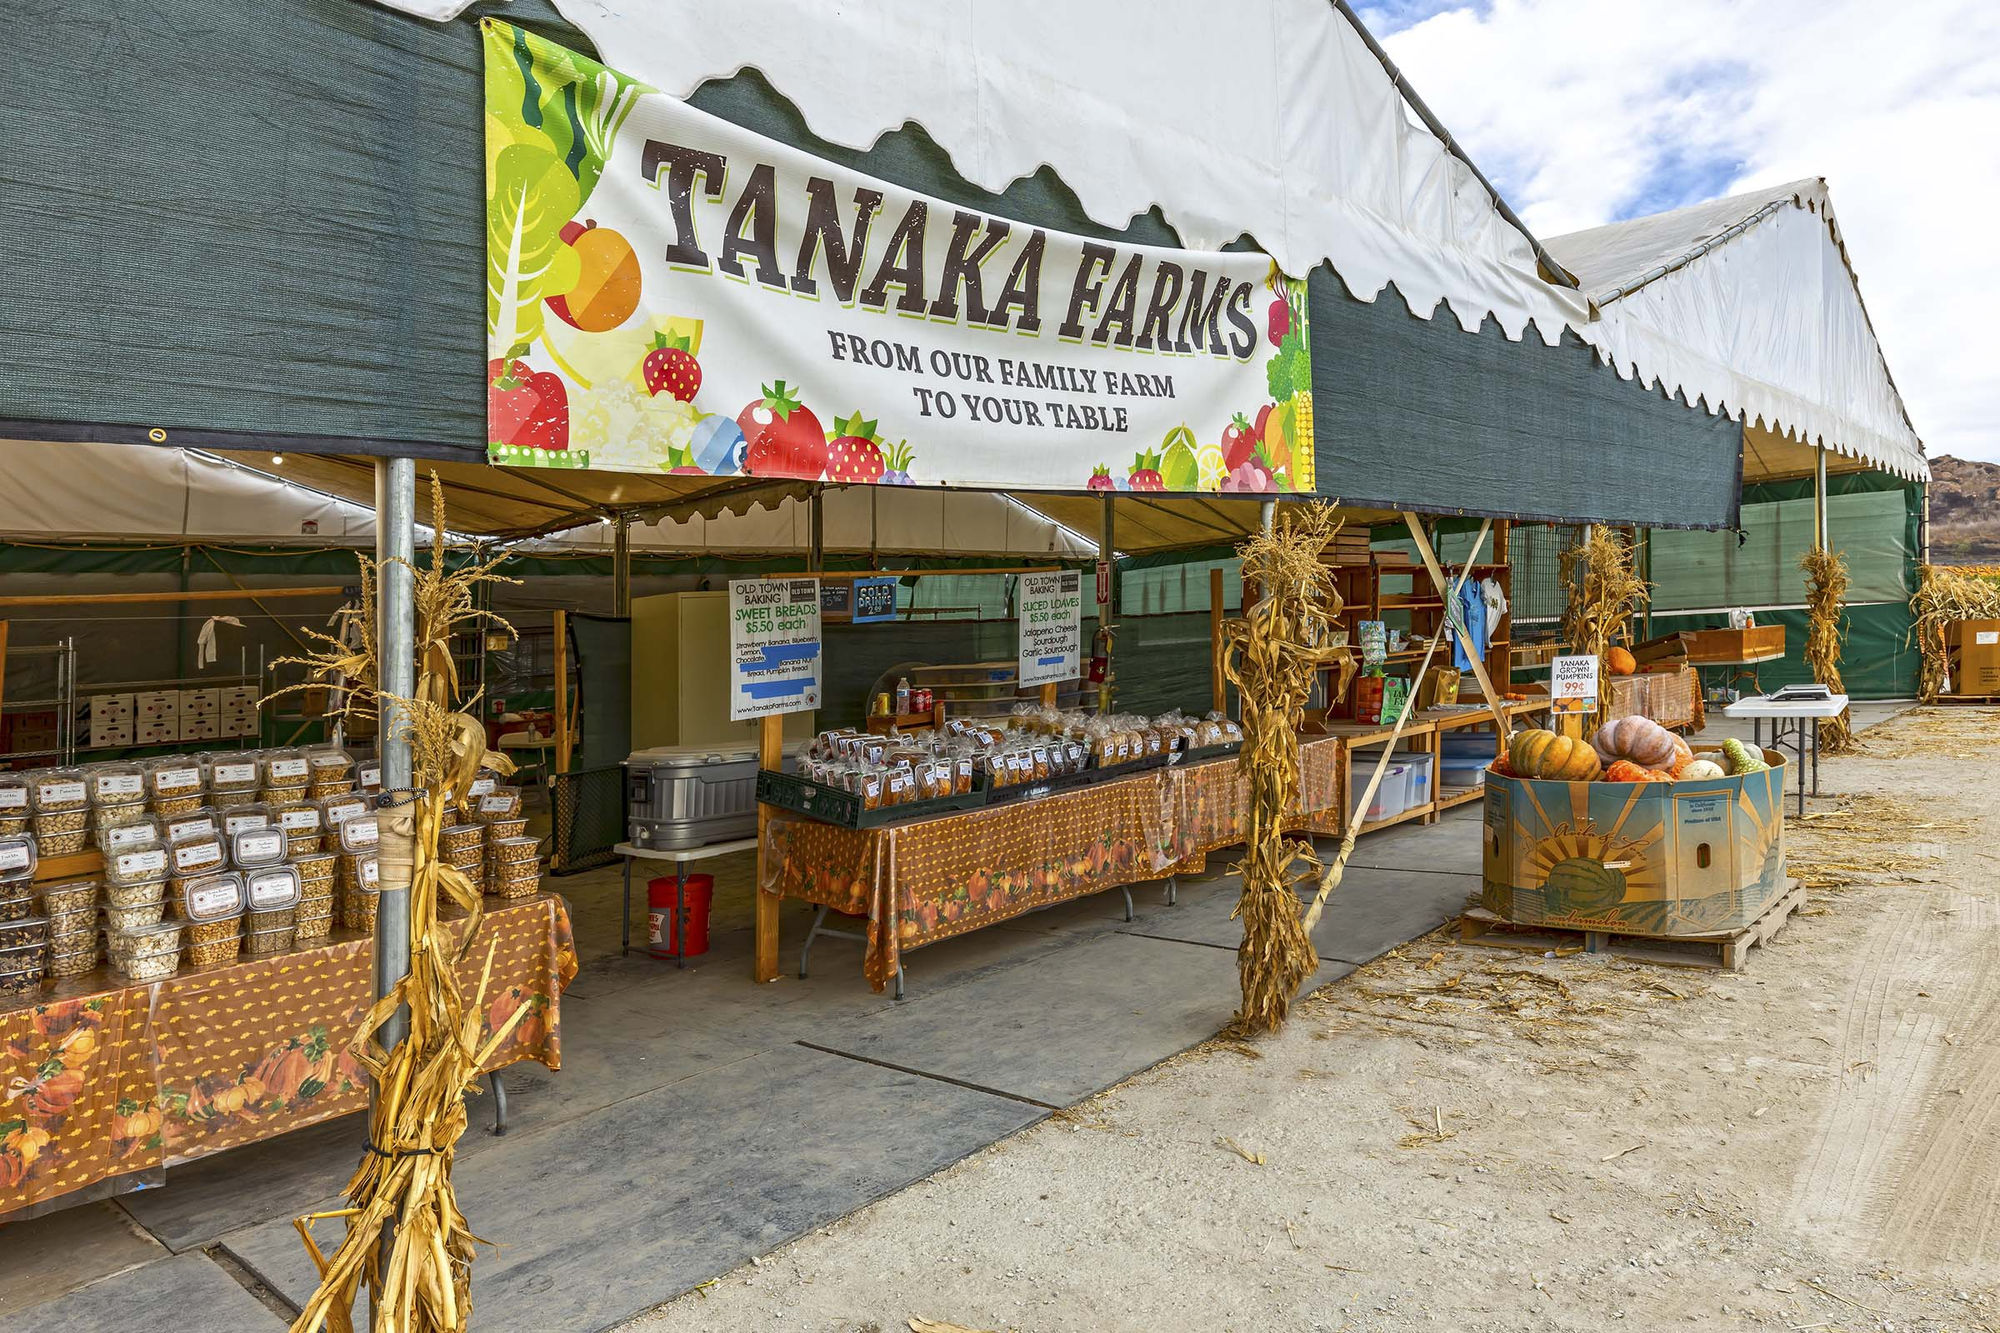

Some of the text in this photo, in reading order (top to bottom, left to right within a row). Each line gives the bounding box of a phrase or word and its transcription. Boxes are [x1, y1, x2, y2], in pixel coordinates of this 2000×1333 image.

[641, 138, 1259, 362] TANAKA FARMS
[827, 330, 1175, 398] FROM OUR FAMILY FARM
[913, 387, 1128, 432] TO YOUR TABLE
[1024, 576, 1060, 587] OLD TOWN
[735, 584, 757, 595] OLD
[758, 582, 789, 594] TOWN
[860, 585, 890, 598] COLD
[1029, 585, 1055, 594] BAKING
[744, 593, 781, 605] BAKING
[858, 595, 892, 608] DRINKS
[1022, 598, 1080, 612] SLICED LOAVES
[735, 603, 817, 621] SWEET BREADS
[1029, 609, 1071, 623] $5.50 each
[745, 618, 806, 633] $5.50 each
[1054, 624, 1078, 633] Cheese
[736, 641, 767, 649] Strawberry
[1033, 634, 1068, 646] Sourdough
[1022, 643, 1078, 658] Garlic Sourdough
[767, 668, 791, 676] Pumpkin
[1555, 672, 1594, 680] PUMPKINS
[1559, 666, 1590, 674] GROWN
[1564, 681, 1585, 692] 99¢
